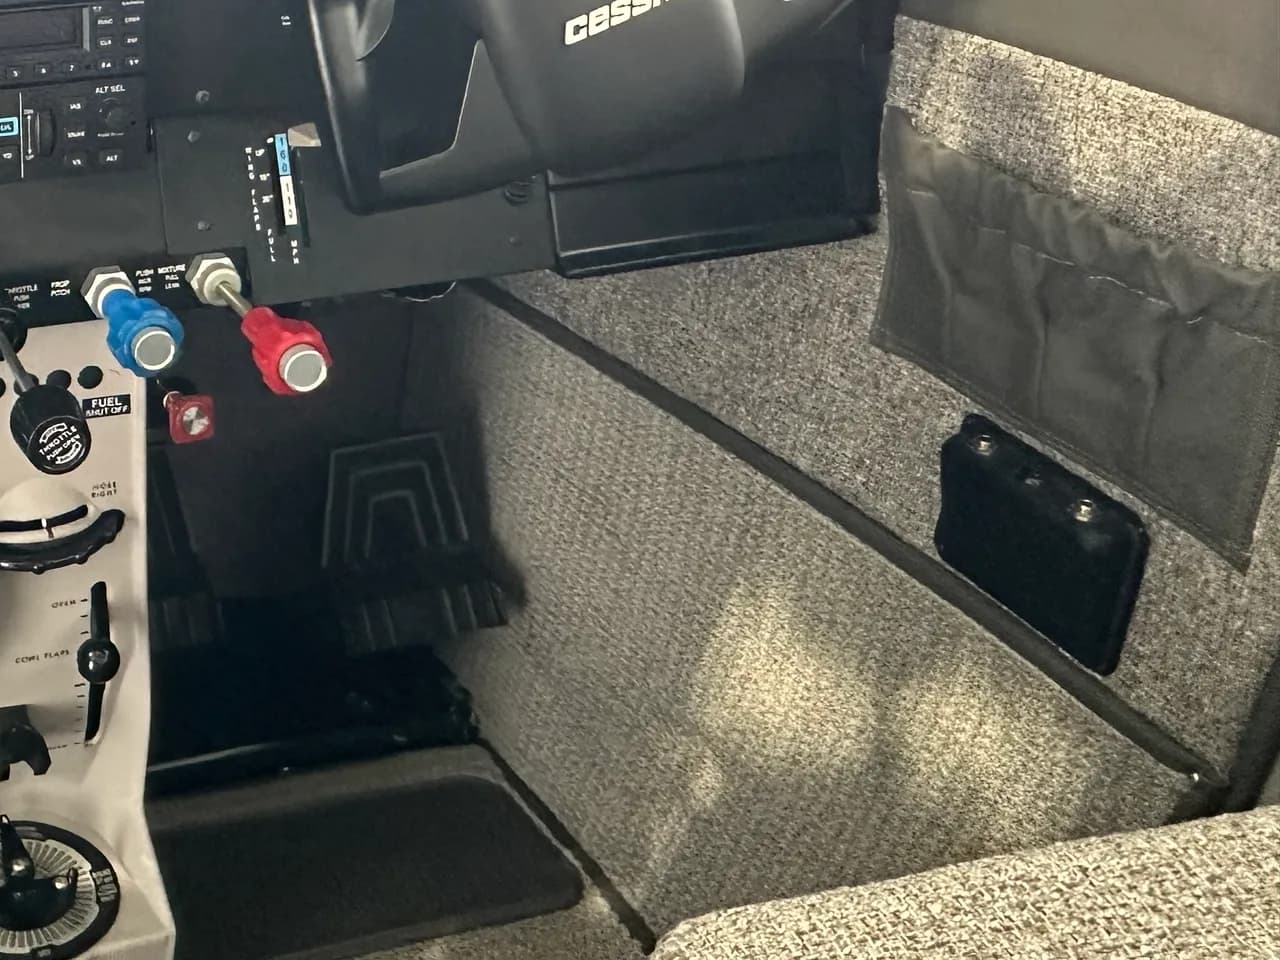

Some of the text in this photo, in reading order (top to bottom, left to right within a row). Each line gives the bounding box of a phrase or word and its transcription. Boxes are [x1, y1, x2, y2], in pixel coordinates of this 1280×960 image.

[91, 396, 123, 409] FUEL
[85, 404, 129, 417] SHUT OFF
[44, 648, 70, 660] FLAPS
